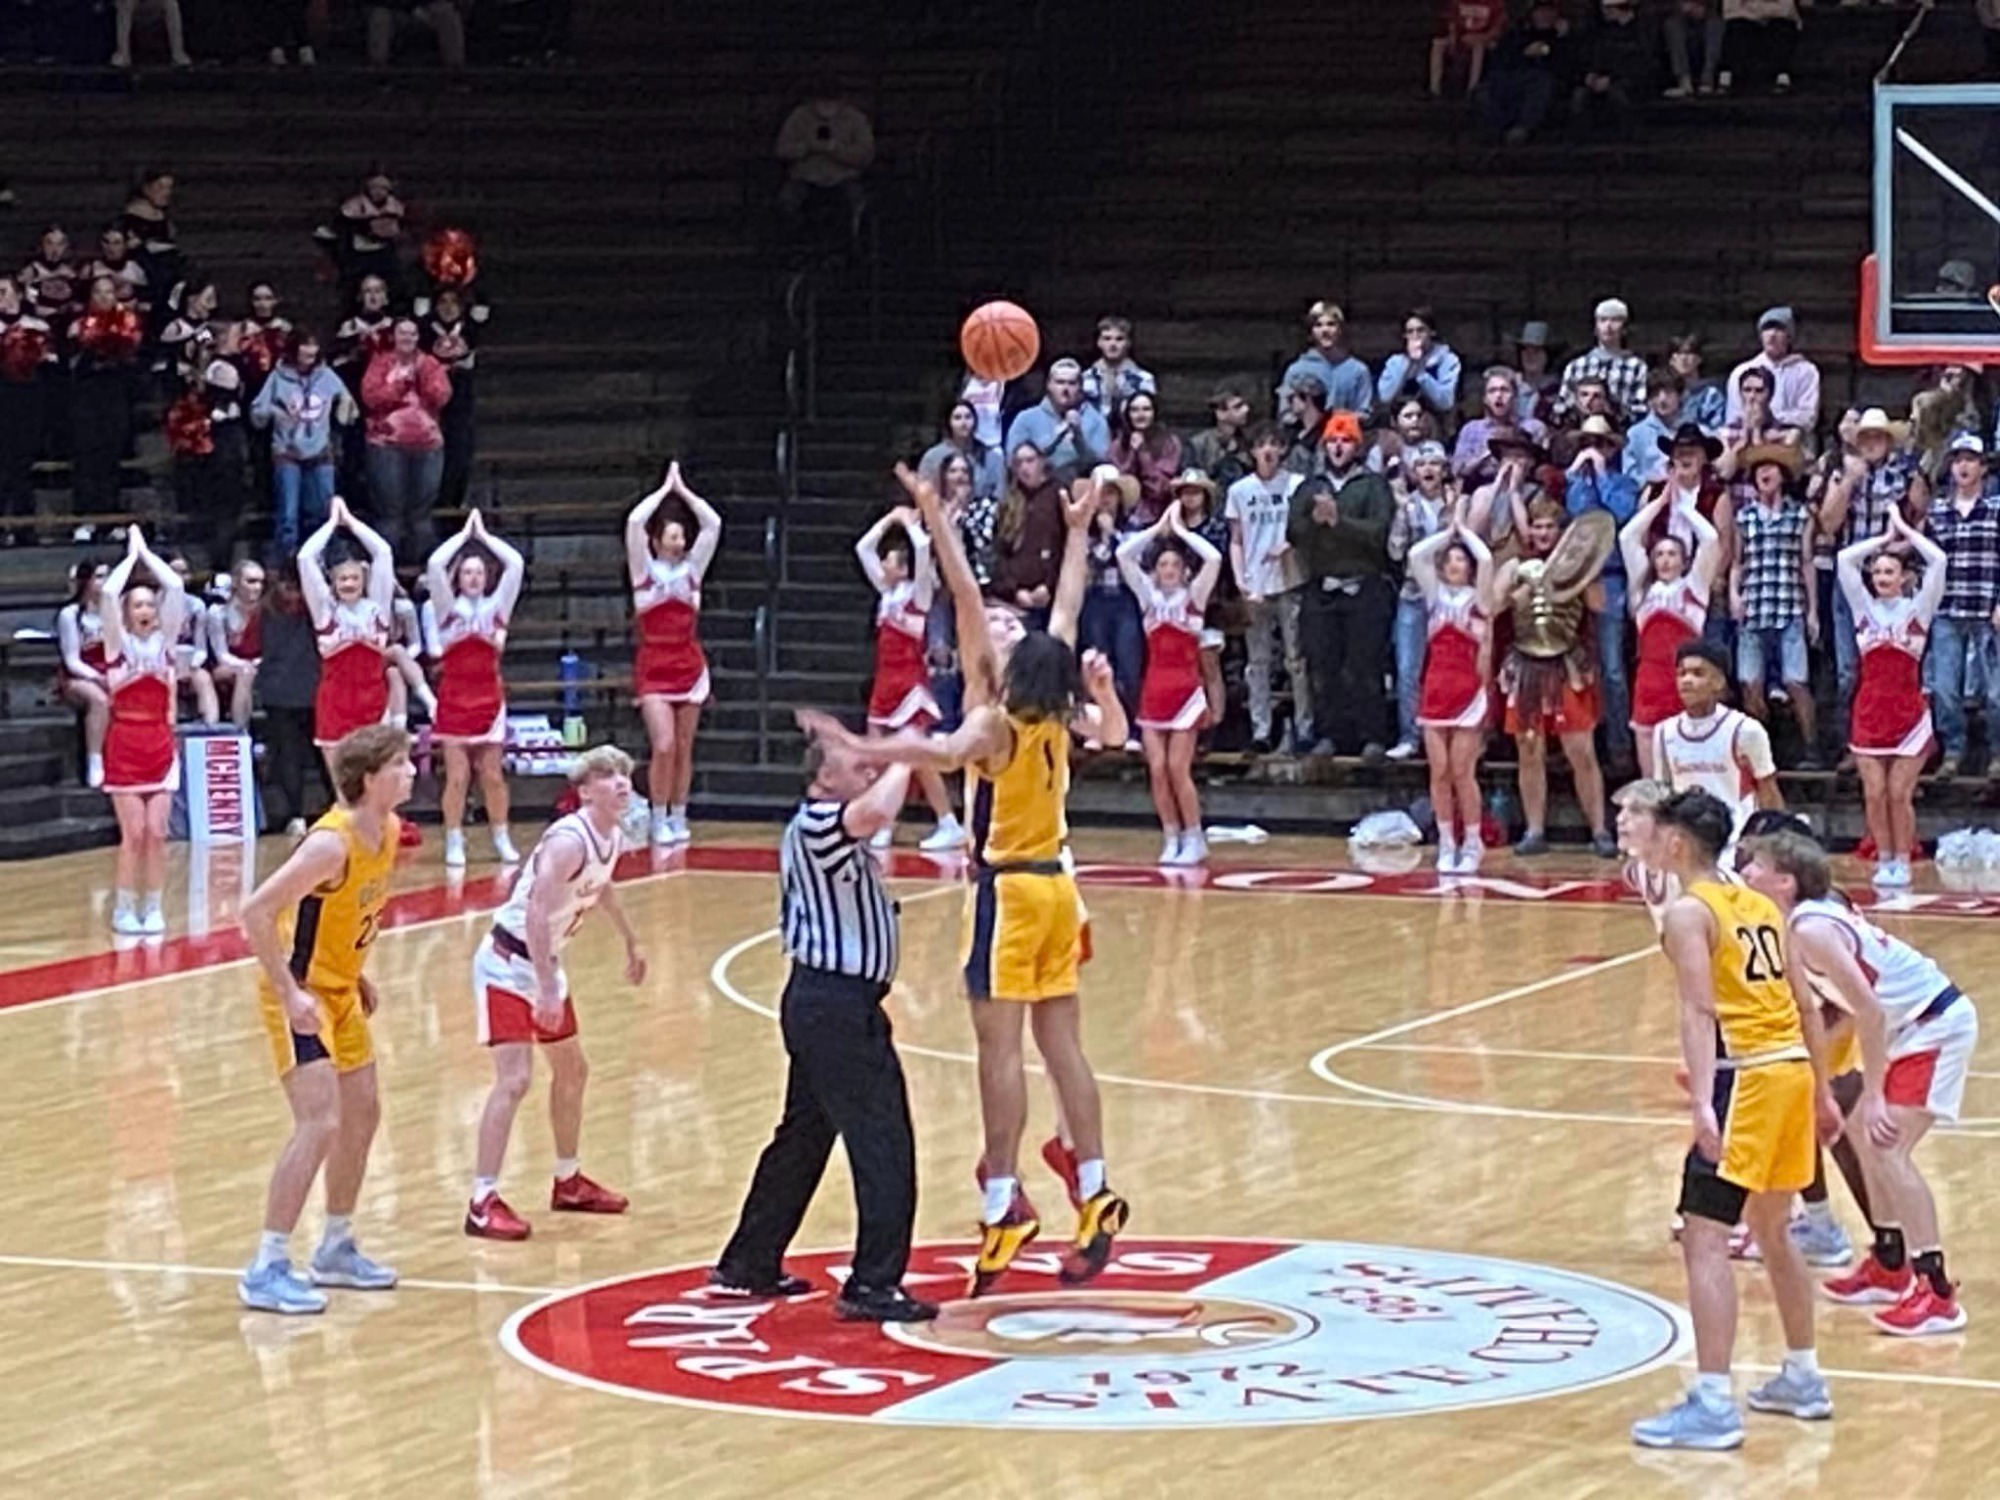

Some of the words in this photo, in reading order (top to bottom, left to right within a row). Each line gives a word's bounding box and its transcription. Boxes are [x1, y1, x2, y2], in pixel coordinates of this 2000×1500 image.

[205, 740, 243, 836] MCHENRY
[1737, 925, 1784, 981] 20
[1012, 1364, 1508, 1409] STATE
[1318, 1261, 1600, 1365] CHAMPS
[1072, 1361, 1325, 1387] 1972
